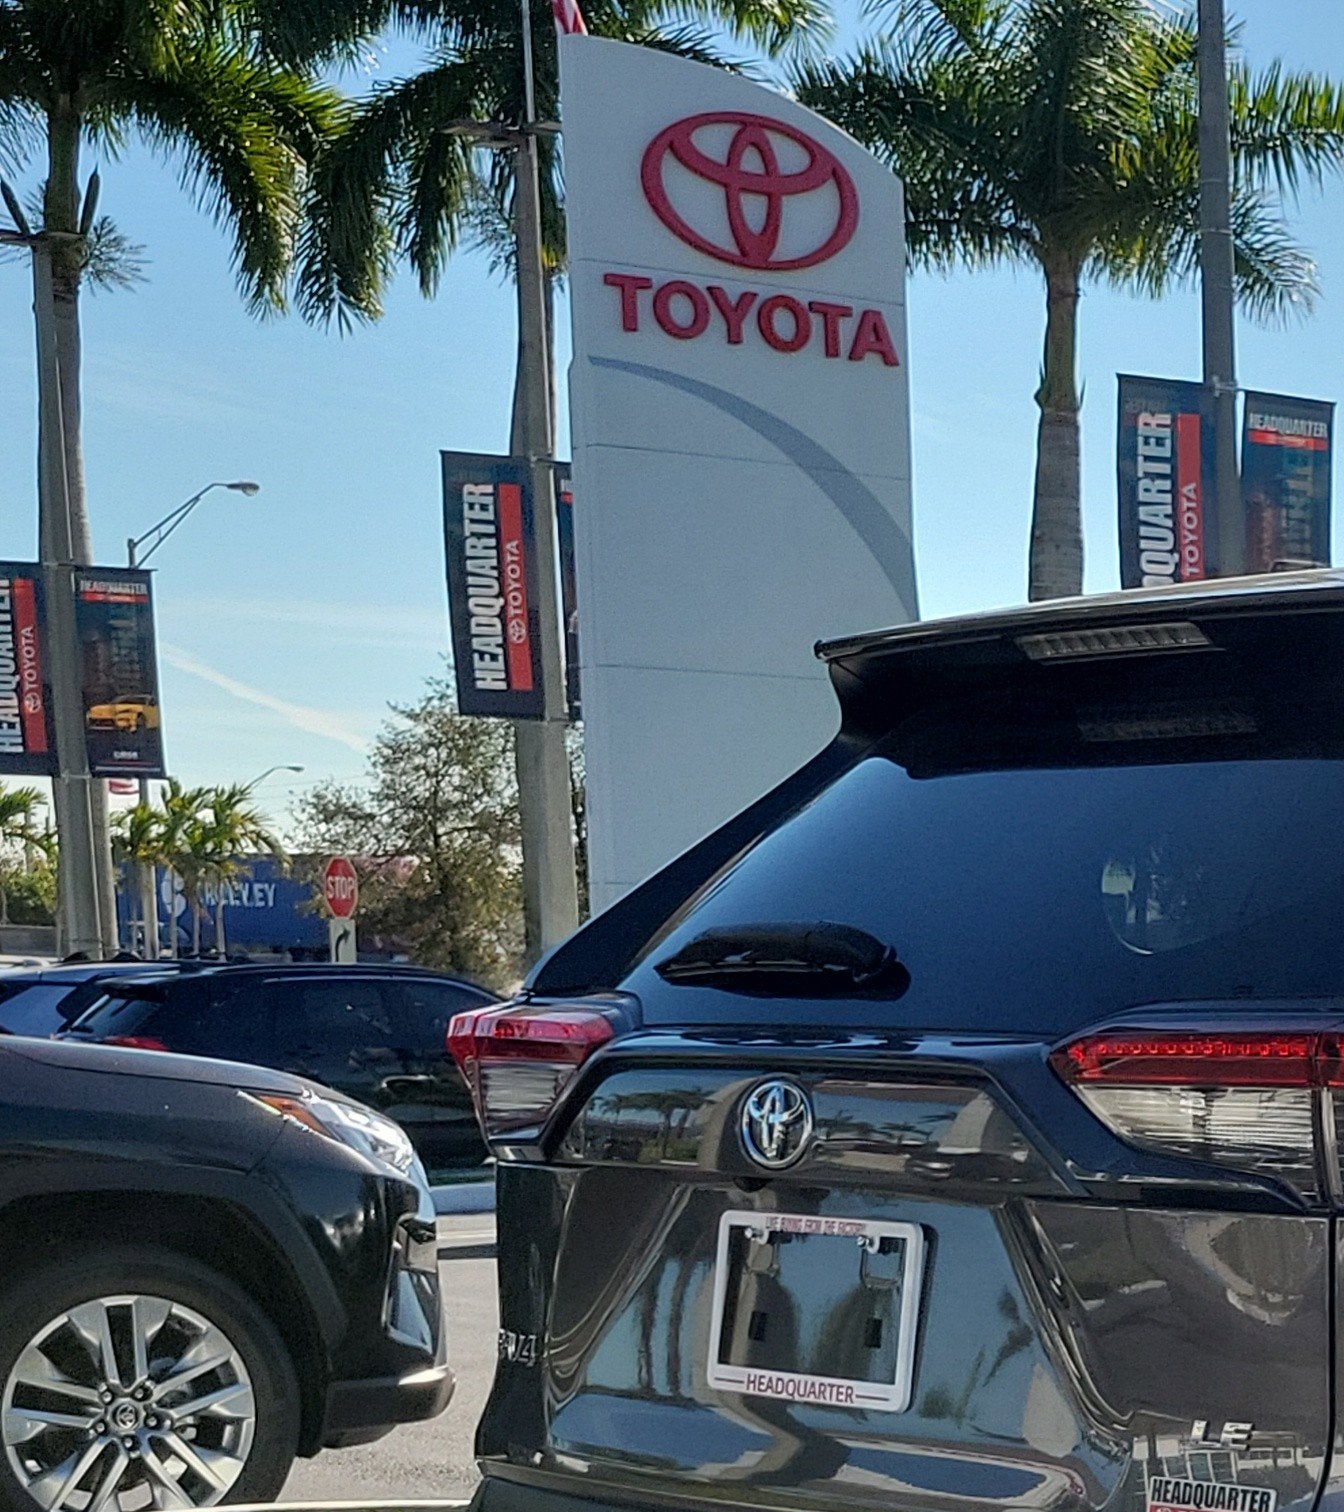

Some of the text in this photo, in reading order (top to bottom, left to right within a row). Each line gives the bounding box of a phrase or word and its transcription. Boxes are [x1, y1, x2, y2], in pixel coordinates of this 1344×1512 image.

[603, 273, 899, 367] TOYOTA
[1182, 483, 1201, 576] TOYOTA
[463, 483, 507, 691] HEADQUARTER
[505, 540, 524, 617] TOYOTA
[21, 626, 39, 691] TOYOTA
[326, 875, 355, 901] STOP
[746, 1373, 855, 1404] HEADQUARTER
[1190, 1419, 1254, 1451] LE
